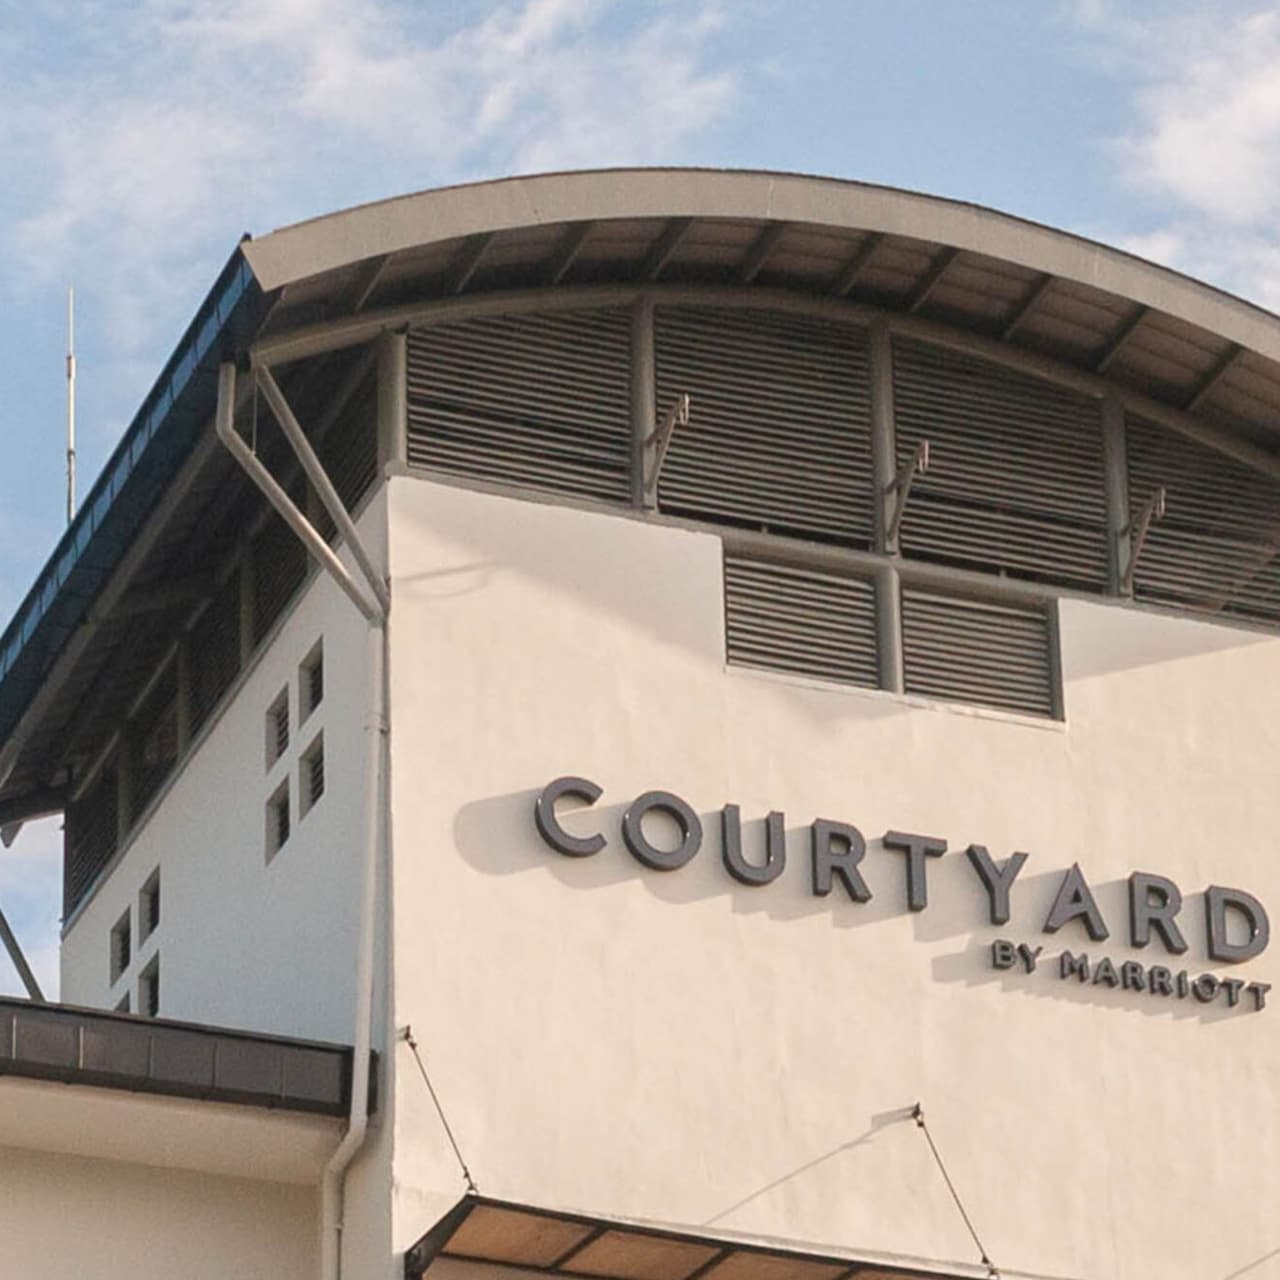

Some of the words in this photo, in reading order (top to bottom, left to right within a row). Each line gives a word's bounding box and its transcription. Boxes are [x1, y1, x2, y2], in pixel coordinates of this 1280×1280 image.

[534, 775, 1271, 963] COURTYARD
[991, 938, 1043, 974] BY
[1060, 950, 1272, 1011] MARRIOTT
